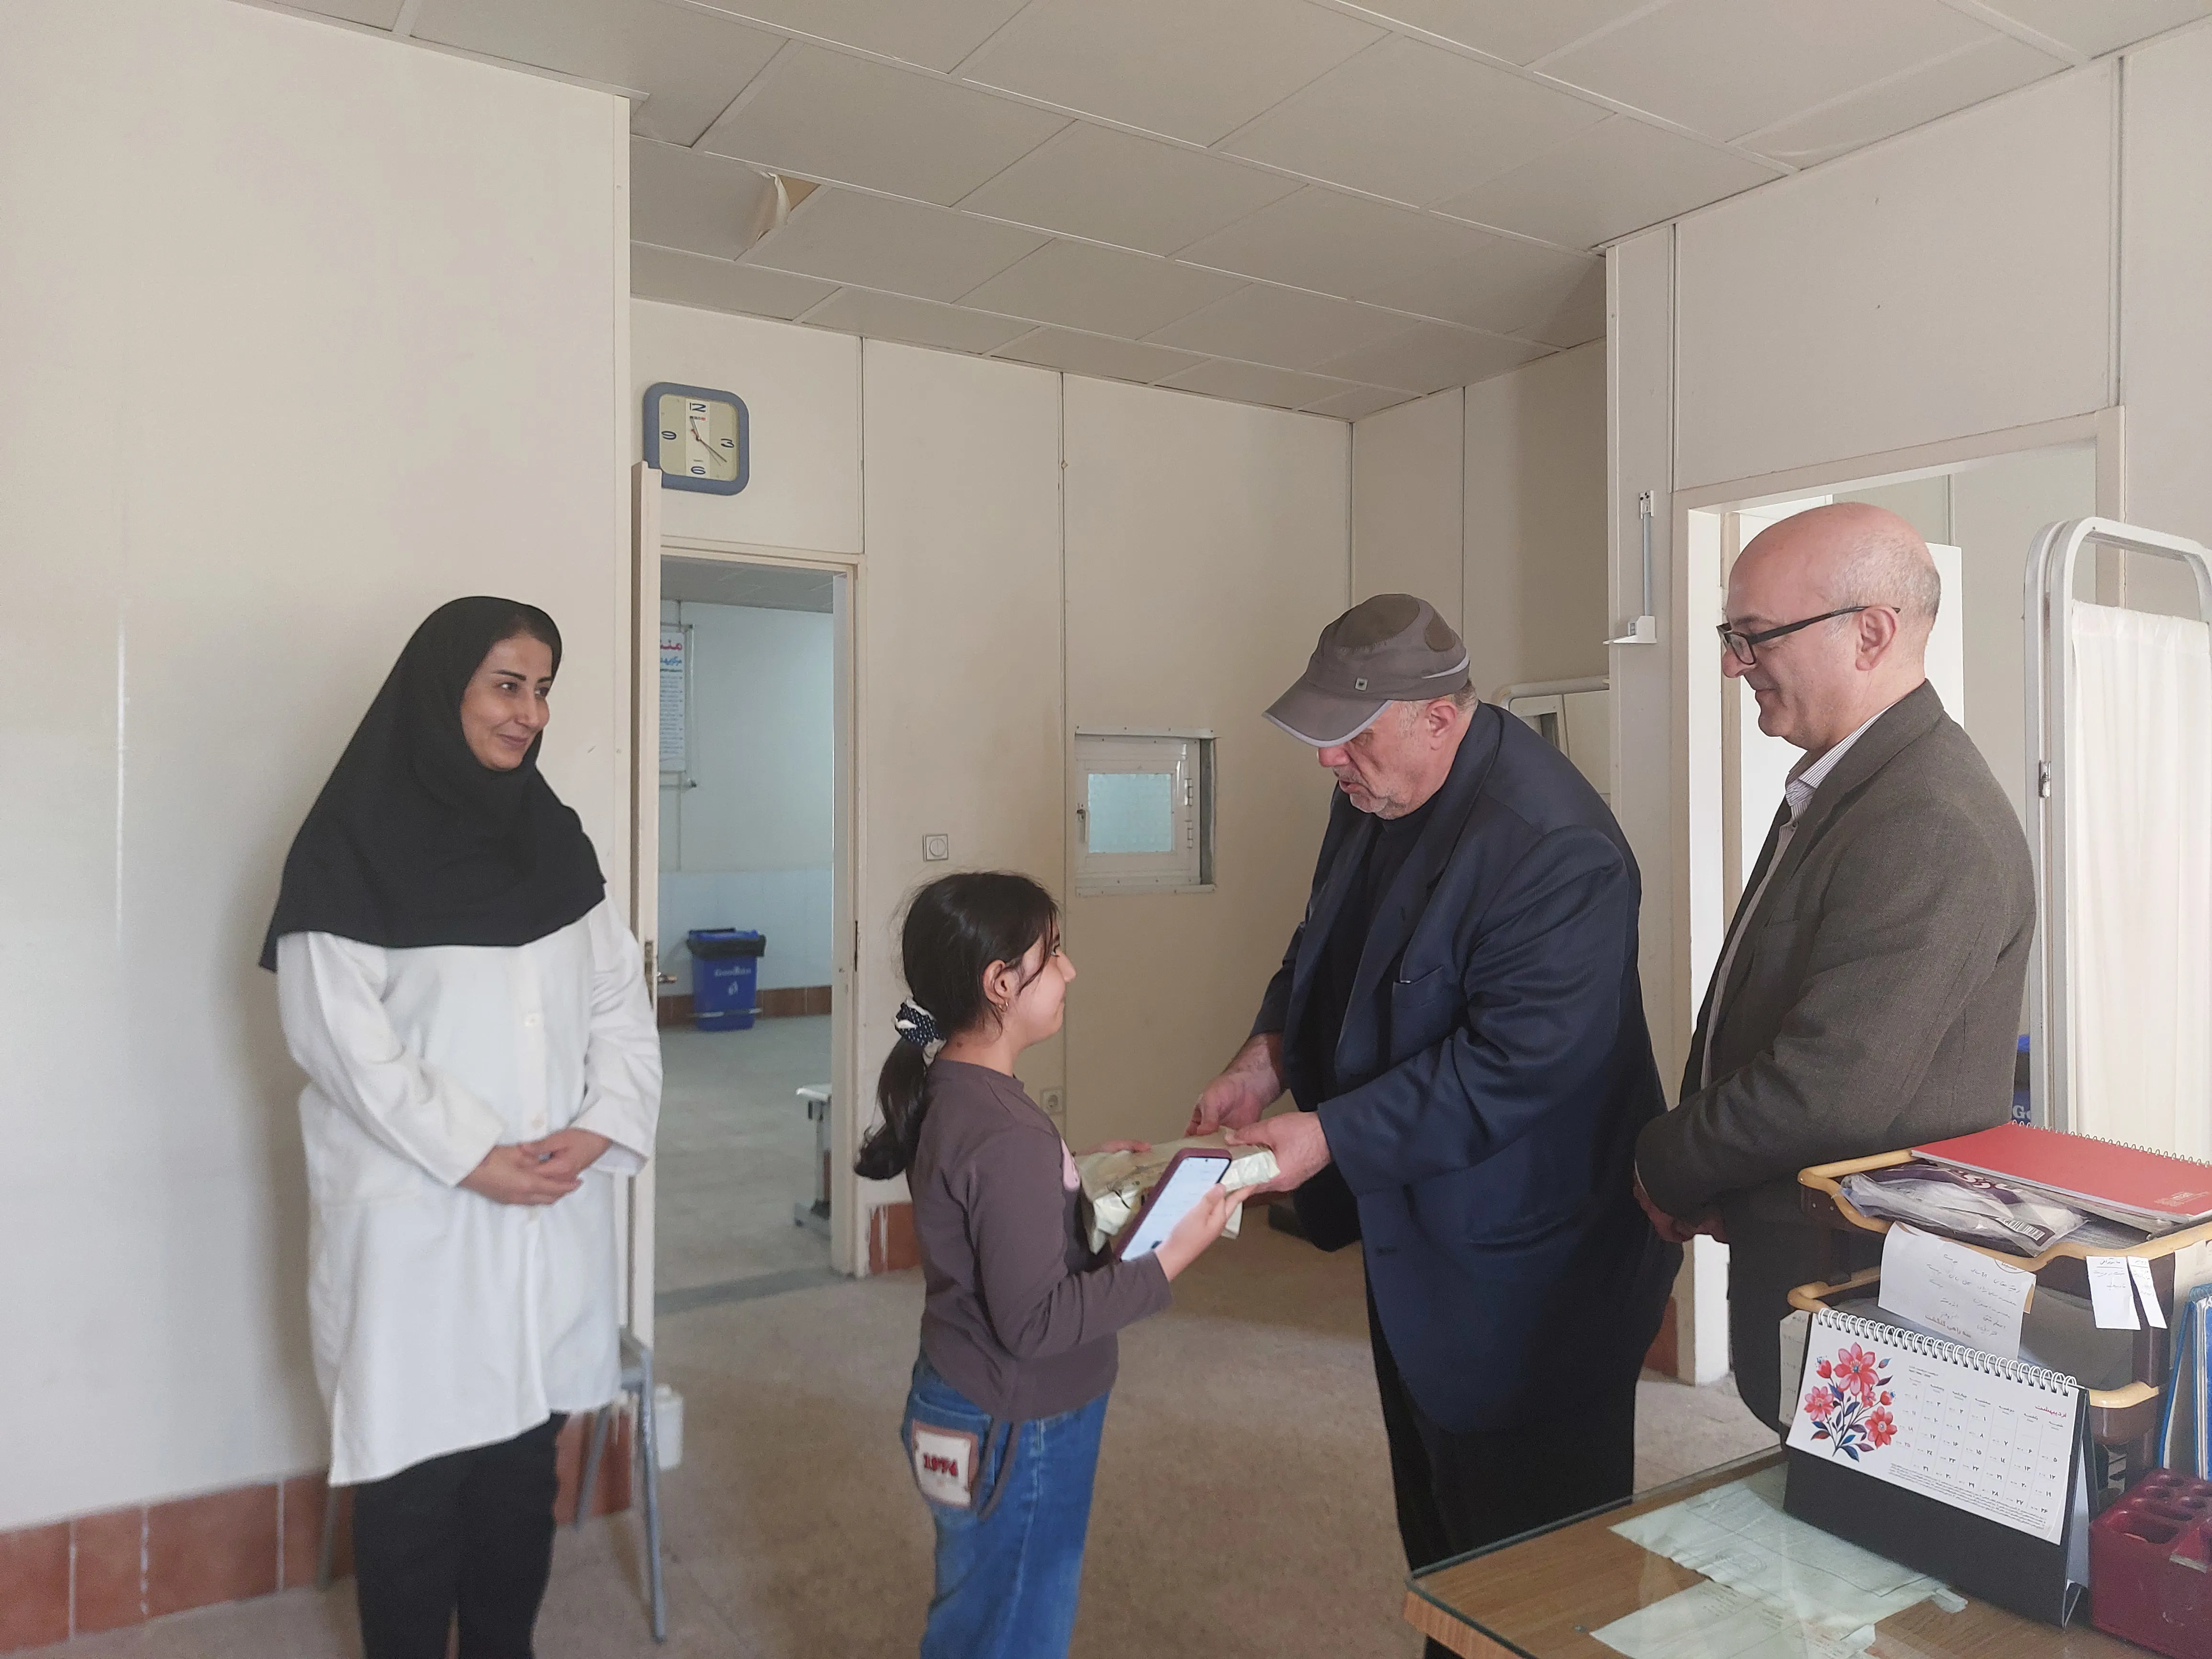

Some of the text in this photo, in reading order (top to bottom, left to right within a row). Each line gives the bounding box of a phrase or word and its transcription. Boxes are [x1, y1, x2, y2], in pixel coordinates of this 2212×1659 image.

[689, 402, 707, 412] 12
[720, 438, 735, 448] 3
[691, 466, 706, 475] 6
[2035, 1405, 2067, 1418] اردیبهشت
